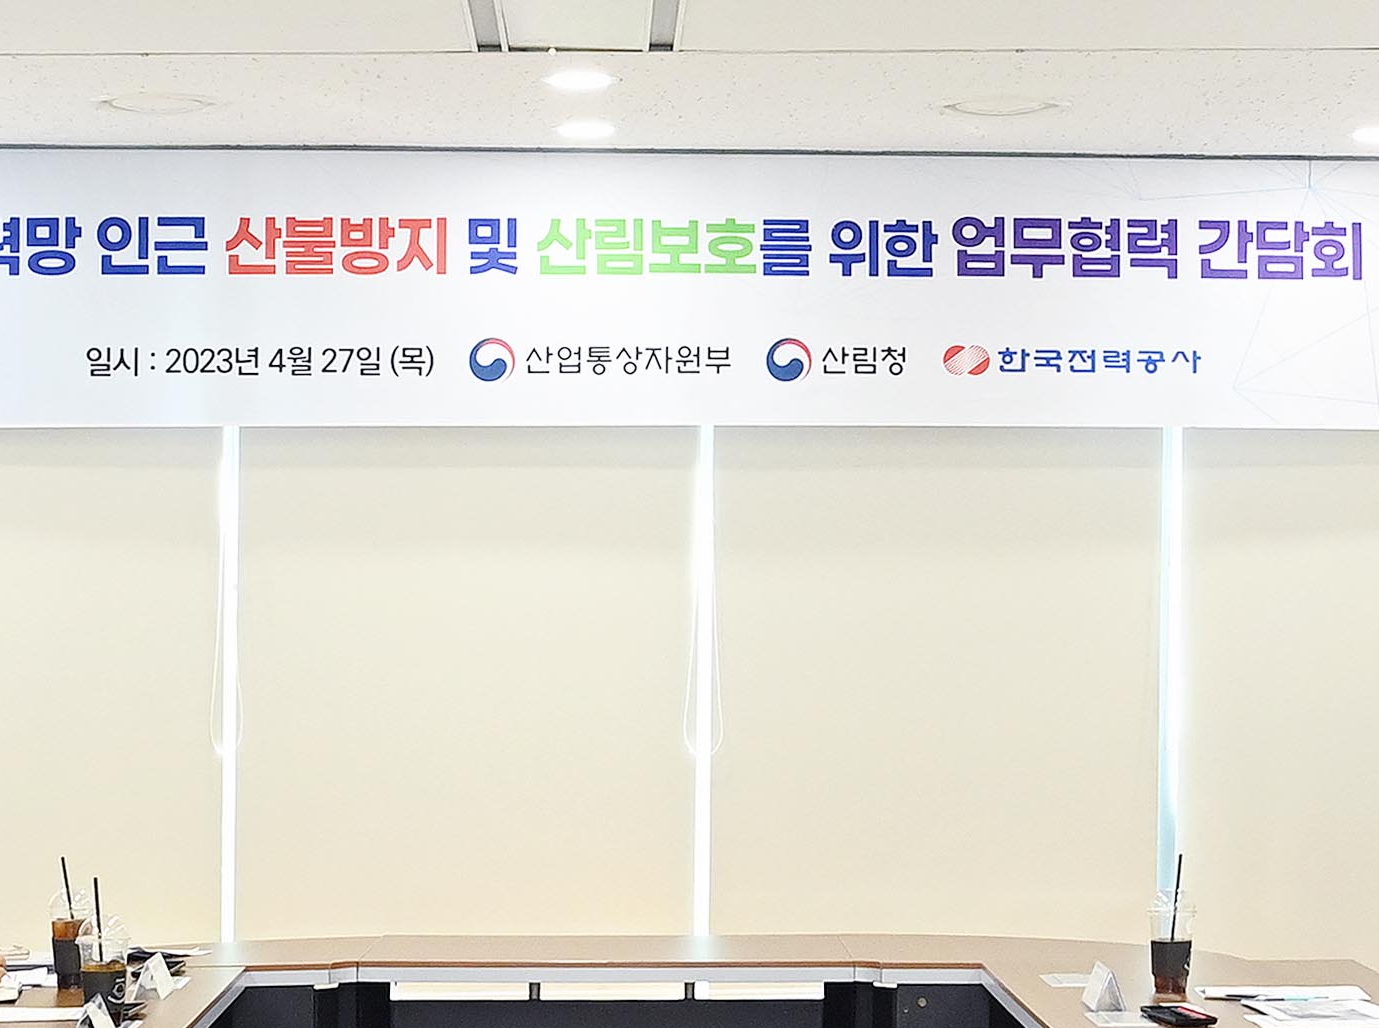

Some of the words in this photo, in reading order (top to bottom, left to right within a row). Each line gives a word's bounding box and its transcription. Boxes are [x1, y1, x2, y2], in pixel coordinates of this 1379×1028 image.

[96, 216, 209, 276] 인근
[225, 216, 448, 277] 산불방지
[468, 217, 518, 276] 및
[538, 217, 813, 277] 산림보호를
[828, 219, 939, 278] 위한
[951, 216, 1179, 280] 업무협력
[1197, 219, 1363, 281] 간담회
[86, 346, 139, 377] 일시
[165, 346, 260, 377] 2023년
[268, 346, 313, 377] 4월
[321, 346, 381, 377] 27일
[390, 345, 434, 378] (목)
[525, 345, 732, 377] 산업통상자원부
[821, 346, 906, 377] 산림청
[997, 346, 1202, 376] 한국전력공사
